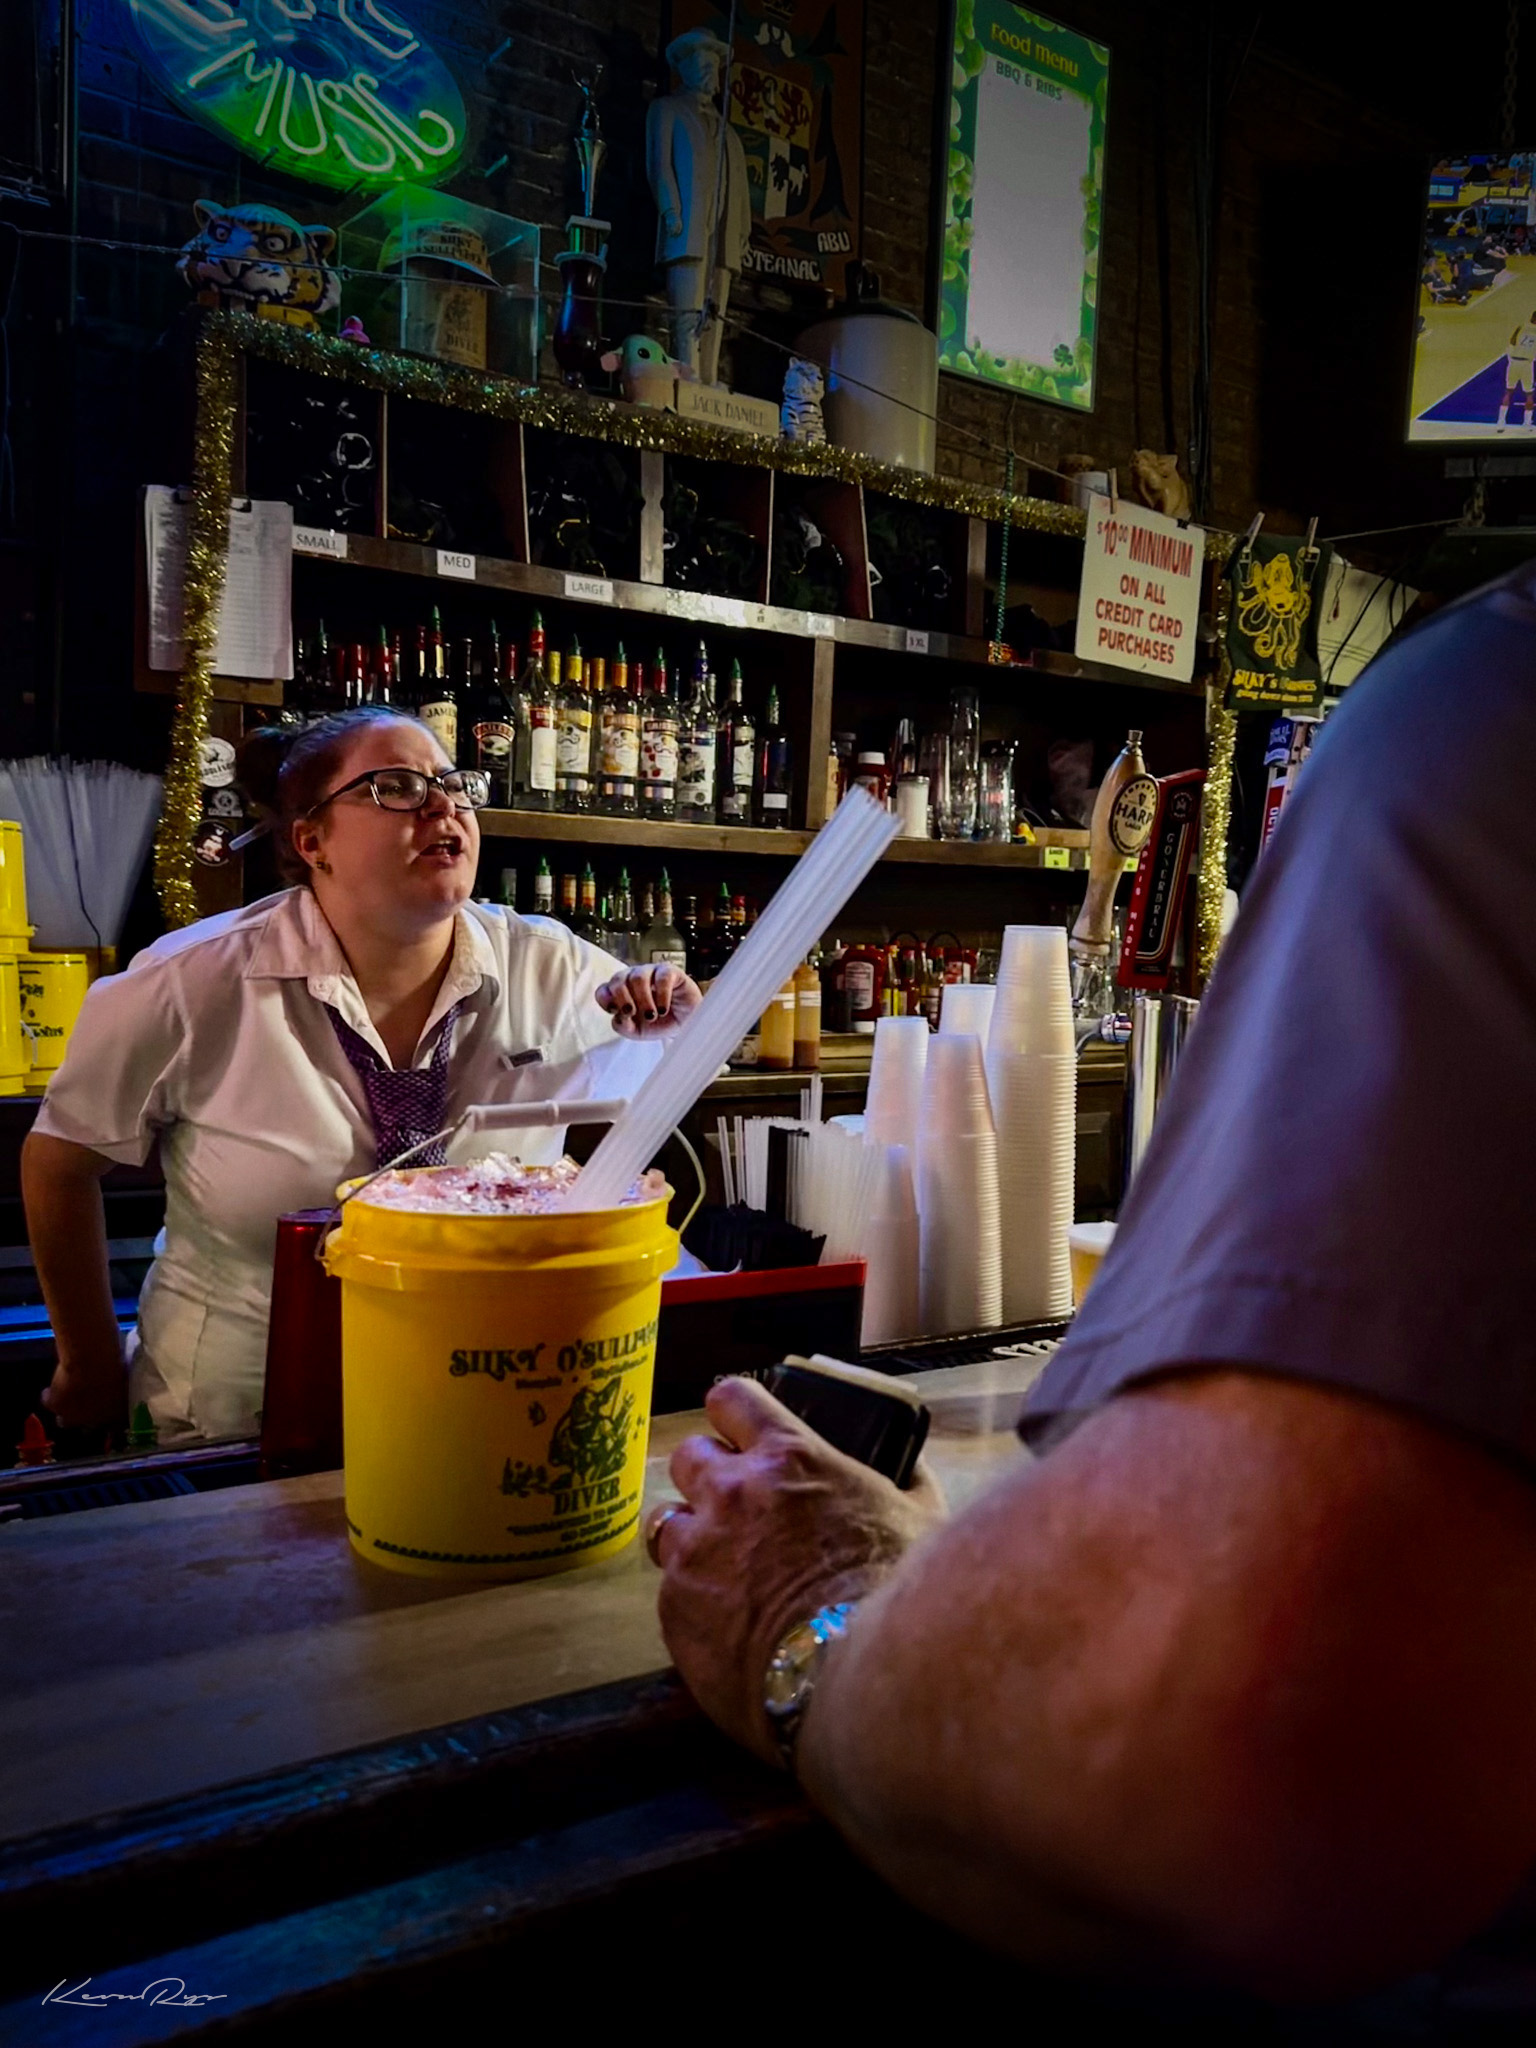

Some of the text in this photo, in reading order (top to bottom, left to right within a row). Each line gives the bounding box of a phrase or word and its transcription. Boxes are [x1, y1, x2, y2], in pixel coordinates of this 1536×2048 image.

[1035, 43, 1079, 77] menu
[995, 60, 1062, 102] BBQ & RIBS
[188, 38, 456, 173] MUSIC
[817, 230, 851, 254] ABU
[692, 394, 764, 426] JACK DANIEL
[296, 534, 338, 551] SMALL
[1129, 525, 1193, 578] MINIMUM
[444, 553, 473, 570] MED
[571, 580, 608, 596] LARGE
[1119, 574, 1167, 605] ON ALL
[1095, 597, 1183, 639] CREDIT CARD
[1098, 624, 1176, 664] PURCHASES
[1116, 801, 1154, 824] HARP
[449, 1342, 547, 1383] SILKY
[553, 1477, 621, 1516] DIVER
